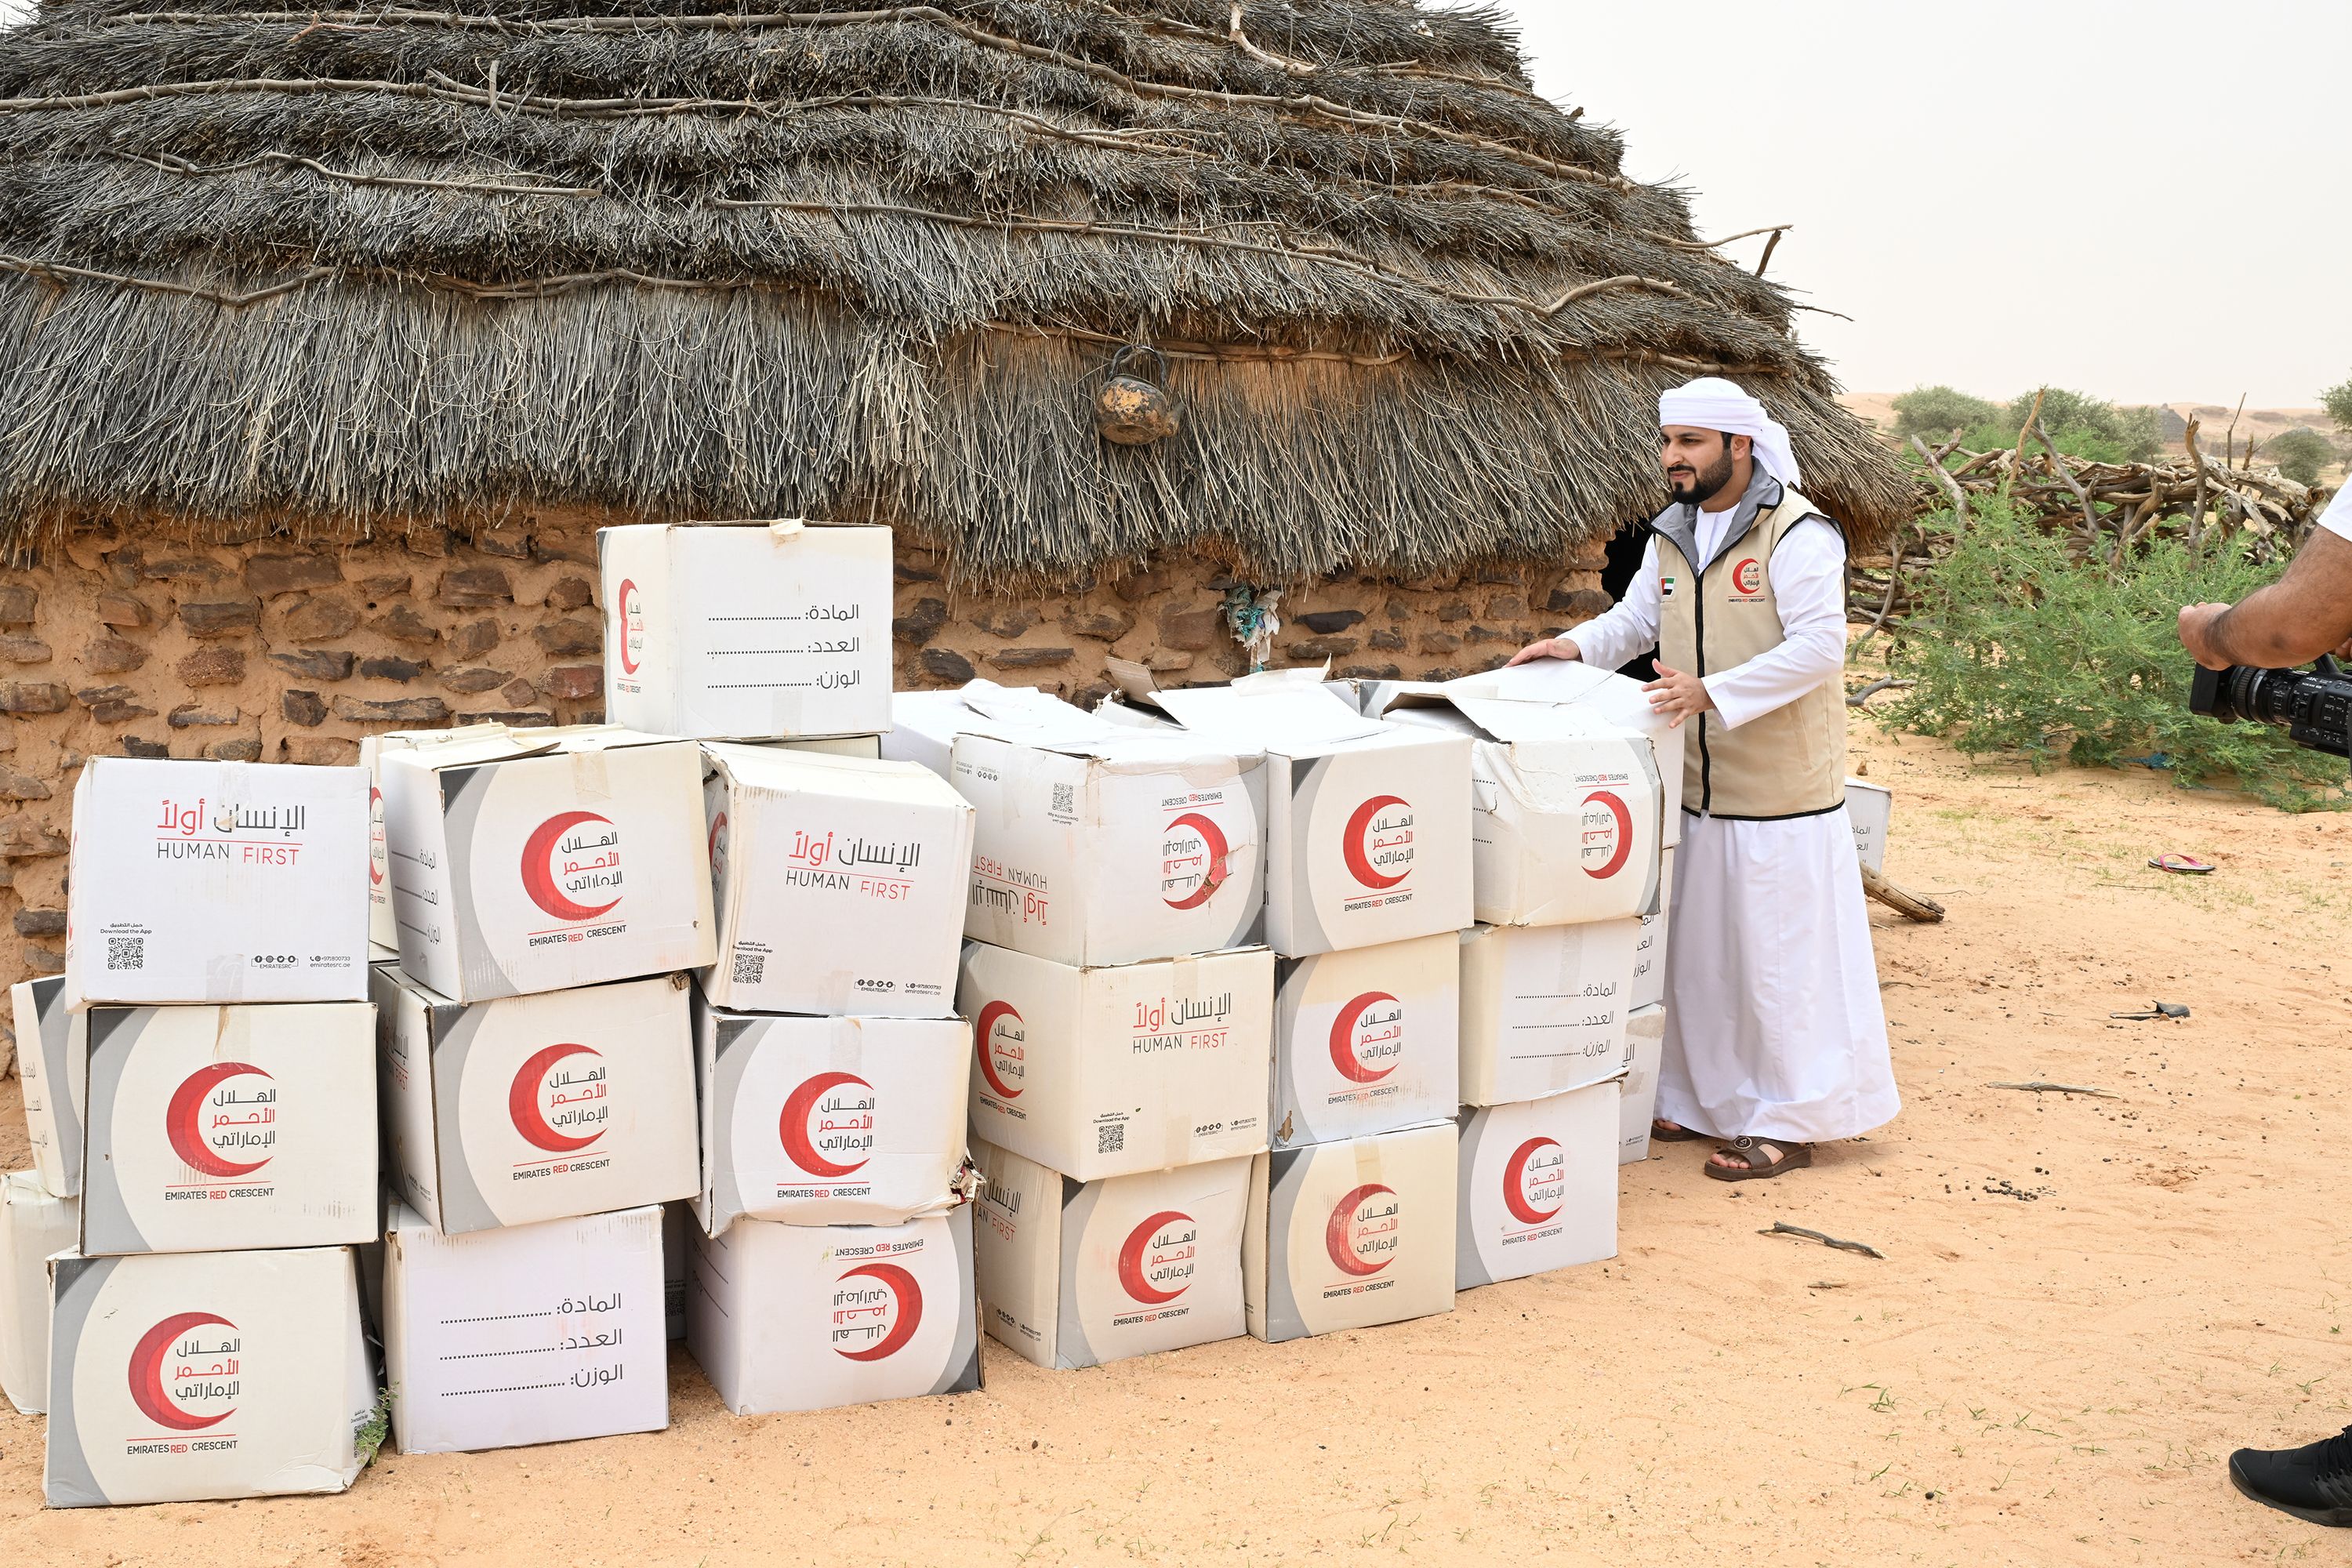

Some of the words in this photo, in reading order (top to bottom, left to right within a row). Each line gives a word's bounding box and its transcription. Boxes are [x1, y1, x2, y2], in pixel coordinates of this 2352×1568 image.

[1162, 797, 1187, 806] CRESCENT
[1198, 792, 1222, 801] EMIRATES
[1373, 815, 1413, 833] الهلال
[561, 832, 618, 853] الهلال
[1373, 830, 1413, 850] الأحمر
[158, 843, 229, 859] HUMAN
[244, 848, 299, 865] FIRST
[564, 851, 619, 875] الأحمر
[839, 838, 920, 872] الإنسان
[1374, 848, 1414, 866] الإماراتي
[975, 855, 1001, 876] FIRST
[566, 871, 622, 892] الإماراتي
[786, 870, 850, 890] HUMAN
[861, 880, 910, 900] FIRST
[1008, 868, 1047, 889] HUMAN
[1345, 901, 1371, 911] EMIRATES
[1385, 894, 1413, 905] CRESCENT
[529, 934, 568, 946] EMIRATES
[568, 933, 583, 942] RED
[587, 925, 626, 938] CRESCENT
[1171, 993, 1230, 1025] الإنسان
[1361, 1009, 1401, 1027] الهلال
[995, 1023, 1025, 1042] الهلال
[1360, 1025, 1401, 1046] الأحمر
[994, 1043, 1024, 1061] الأحمر
[1133, 1035, 1182, 1054] HUMAN
[1191, 1033, 1227, 1049] FIRST
[1361, 1042, 1401, 1060] الإماراتي
[550, 1067, 606, 1087] الهلال
[995, 1060, 1025, 1079] الإماراتي
[213, 1089, 276, 1106] الهلال
[551, 1083, 607, 1108] الأحمر
[1328, 1094, 1356, 1104] EMIRATES
[1370, 1086, 1399, 1097] CRESCENT
[821, 1098, 875, 1112] الهلال
[980, 1097, 997, 1109] EMIRATES
[997, 1105, 1006, 1114] RED
[1007, 1107, 1026, 1120] CRESCENT
[212, 1108, 275, 1129] الأحمر
[552, 1105, 608, 1127] الإماراتي
[819, 1115, 873, 1133] الأحمر
[213, 1131, 275, 1149] الإماراتي
[819, 1135, 873, 1151] الإماراتي
[513, 1168, 551, 1181] EMIRATES
[553, 1164, 568, 1174] RED
[570, 1159, 611, 1172] CRESCENT
[1528, 1154, 1563, 1171] الهلال
[1529, 1169, 1563, 1189] الأحمر
[165, 1191, 207, 1200] EMIRATES
[210, 1191, 227, 1200] RED
[229, 1188, 274, 1198] CRESCENT
[778, 1189, 814, 1198] EMIRATES
[815, 1189, 829, 1198] RED
[833, 1188, 871, 1196] CRESCENT
[1529, 1185, 1563, 1203] الإماراتي
[1357, 1203, 1398, 1221] الهلال
[992, 1218, 1014, 1243] FIRST
[1357, 1218, 1398, 1239] الأحمر
[1502, 1236, 1526, 1246] EMIRATES
[1538, 1228, 1563, 1239] CRESCENT
[876, 1243, 891, 1252] RED
[892, 1239, 924, 1252] EMIRATES
[1153, 1229, 1196, 1248] الهلال
[1357, 1236, 1398, 1254] الإماراتي
[835, 1247, 874, 1256] CRESCENT
[1151, 1246, 1195, 1267] الأحمر
[1151, 1263, 1194, 1282] الإماراتي
[1323, 1289, 1351, 1298] EMIRATES
[1365, 1280, 1395, 1291] CRESCENT
[1113, 1316, 1143, 1326] EMIRATES
[1158, 1308, 1189, 1319] CRESCENT
[176, 1338, 240, 1357] الهلال
[175, 1359, 239, 1380] الأحمر
[176, 1381, 239, 1400] الإماراتي
[127, 1445, 169, 1454] EMIRATES
[170, 1444, 187, 1454] RED
[192, 1440, 238, 1451] CRESCENT
